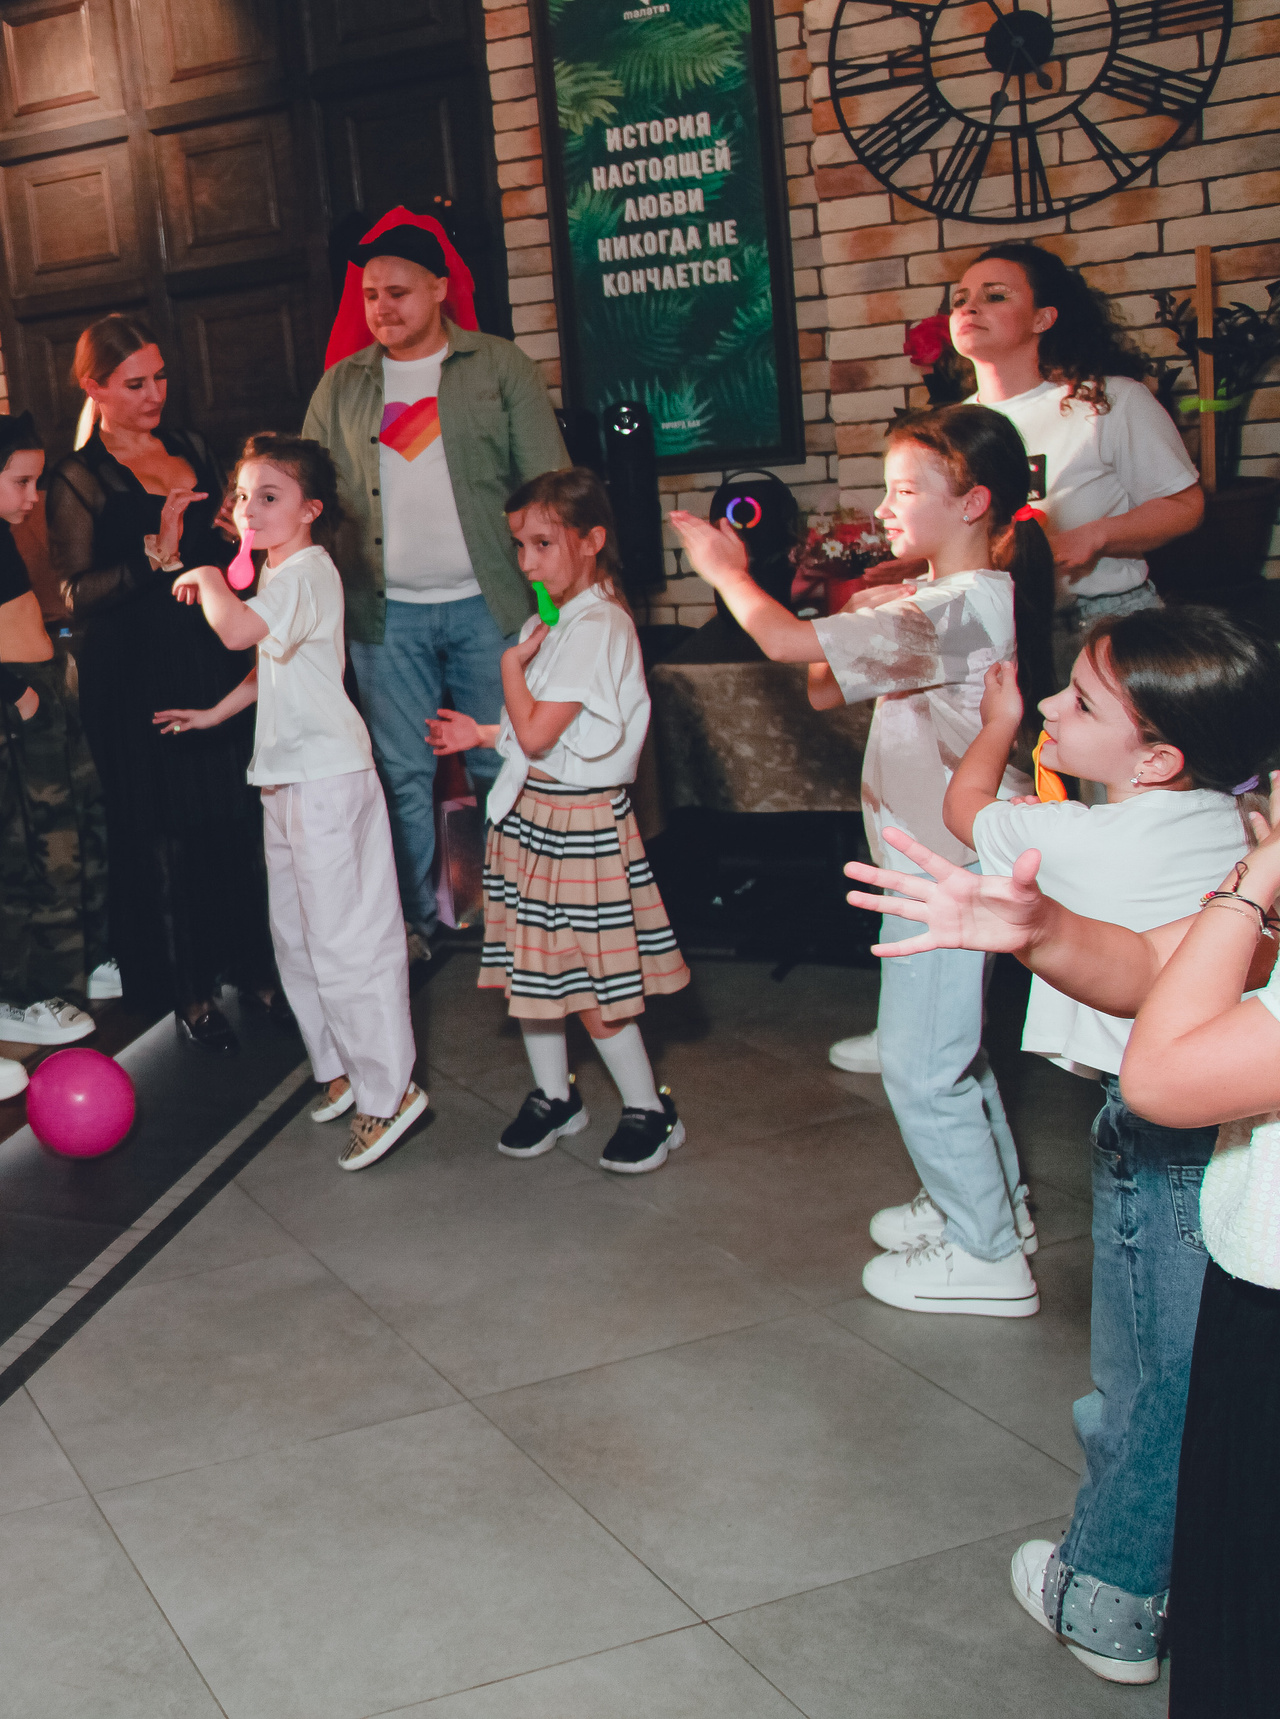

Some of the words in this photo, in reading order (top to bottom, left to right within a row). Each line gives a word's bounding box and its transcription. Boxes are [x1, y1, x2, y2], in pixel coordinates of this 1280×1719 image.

[606, 111, 711, 153] ИСТОРИЯ
[592, 139, 731, 191] НАСТОЯЩЕЙ
[624, 188, 705, 223] ЛЮБВИ
[597, 225, 702, 262] НИКОГДА
[708, 219, 739, 247] НЕ
[602, 257, 739, 298] КОНЧАЕТСЯ.
